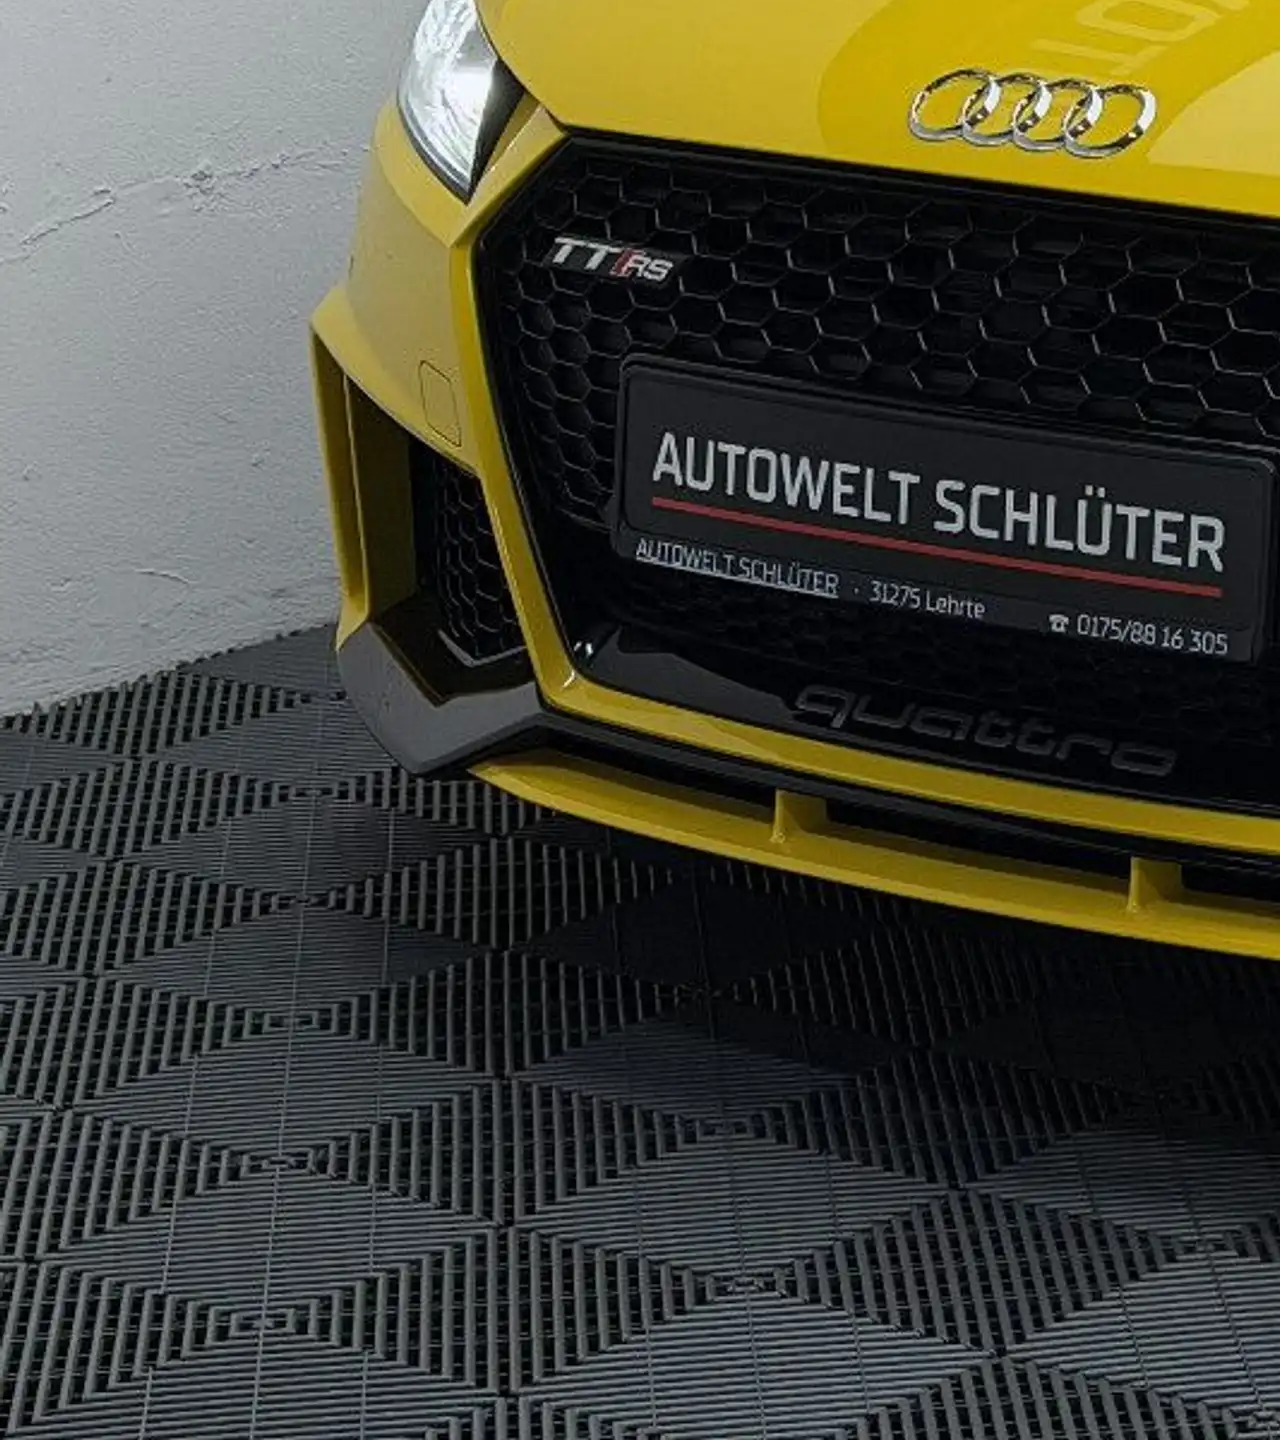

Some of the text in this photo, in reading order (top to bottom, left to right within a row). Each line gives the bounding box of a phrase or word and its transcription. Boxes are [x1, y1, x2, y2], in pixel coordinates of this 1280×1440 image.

[652, 431, 1226, 573] AUTOWELT SCHLÜTER
[635, 537, 986, 620] AUTOWELT SCHLÜTER 31275 Lehrte
[1077, 613, 1228, 656] 0175/88 16 305
[794, 683, 1178, 778] quattro
